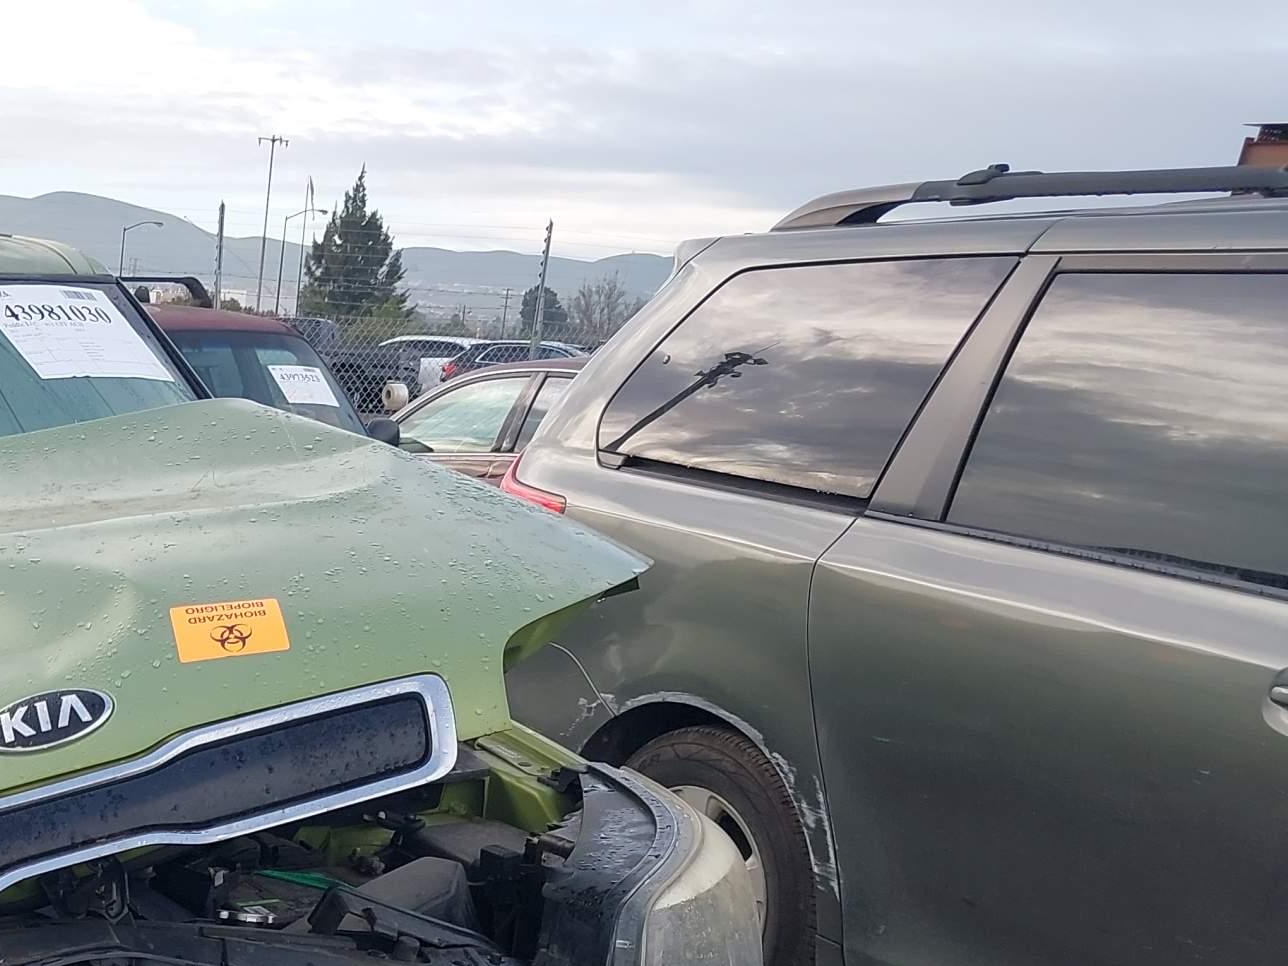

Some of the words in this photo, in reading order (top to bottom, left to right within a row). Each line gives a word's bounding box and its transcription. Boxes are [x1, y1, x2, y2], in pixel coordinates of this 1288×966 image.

[4, 303, 112, 324] 43981030
[185, 601, 264, 615] BIOPELIGRO
[187, 609, 267, 625] BIOHAZARD
